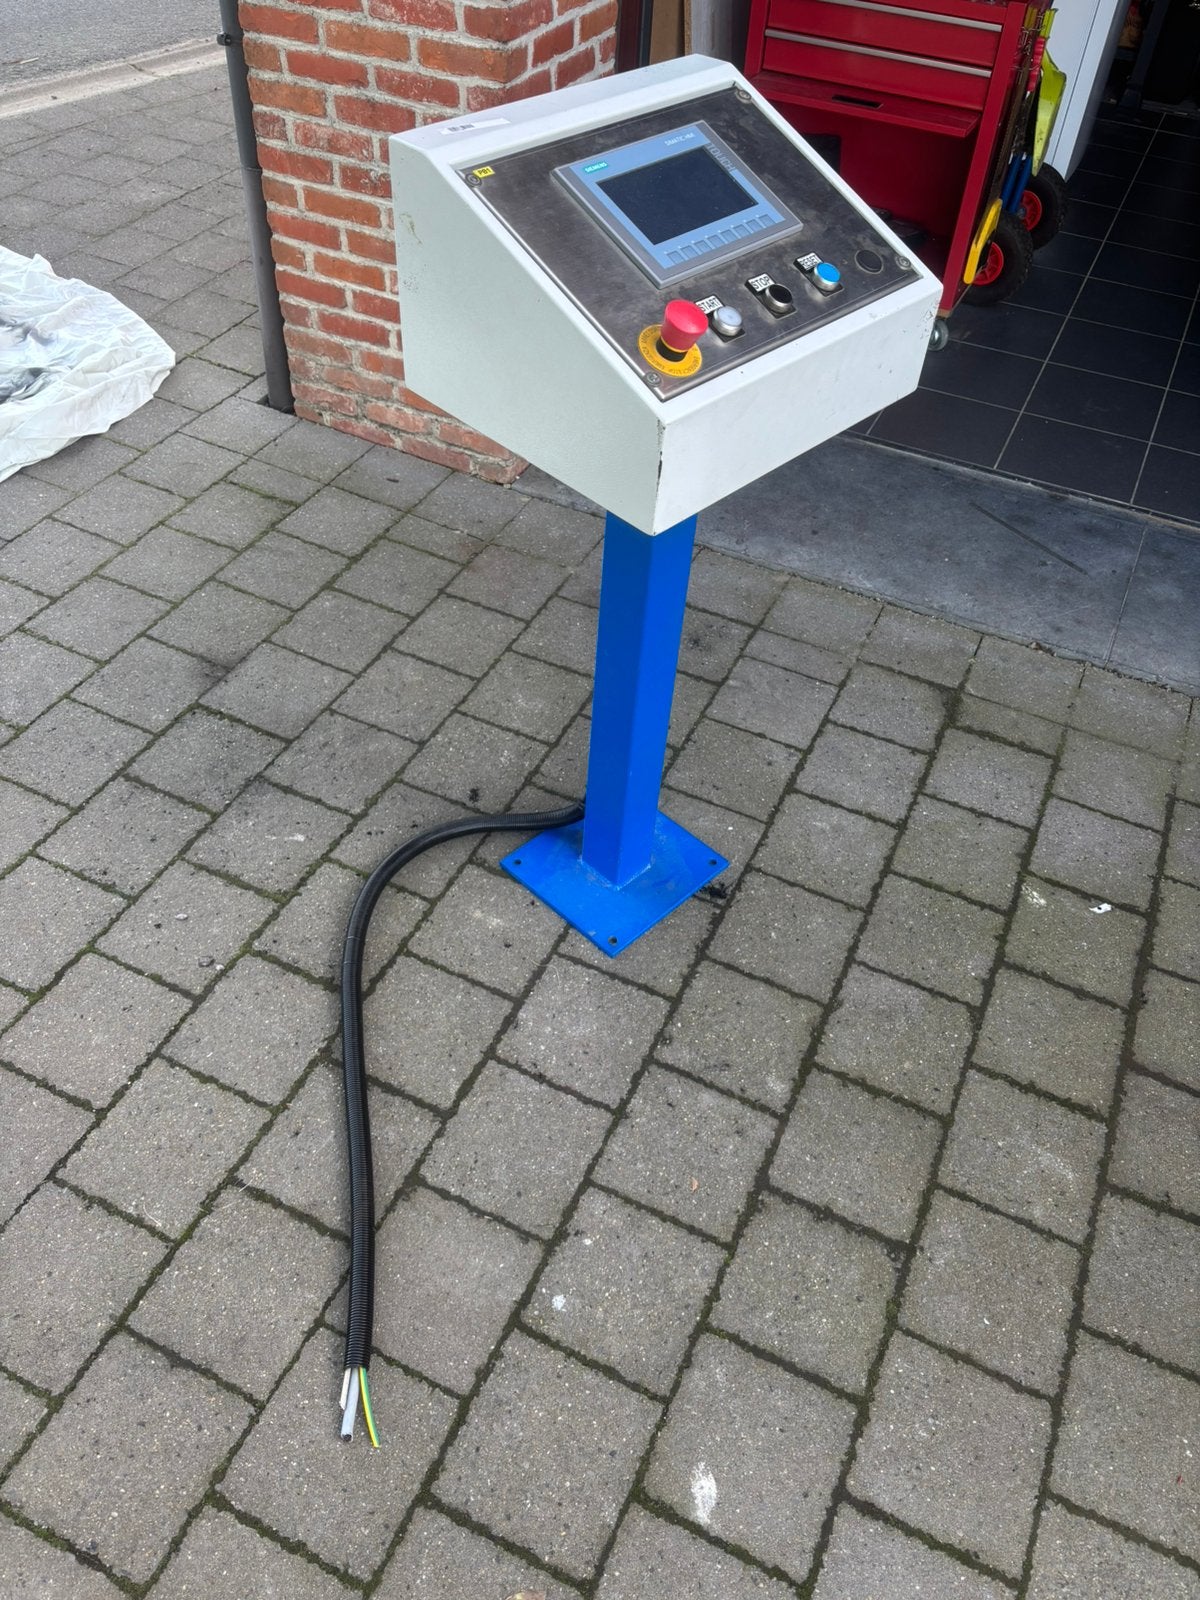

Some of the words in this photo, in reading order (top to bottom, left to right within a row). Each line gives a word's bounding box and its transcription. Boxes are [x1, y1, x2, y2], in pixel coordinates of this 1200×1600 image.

[706, 142, 736, 170] TOUCH
[477, 167, 491, 175] PB1
[585, 162, 608, 173] SIEMENS
[799, 254, 820, 270] RESET
[750, 276, 770, 290] STOP
[697, 297, 720, 311] START
